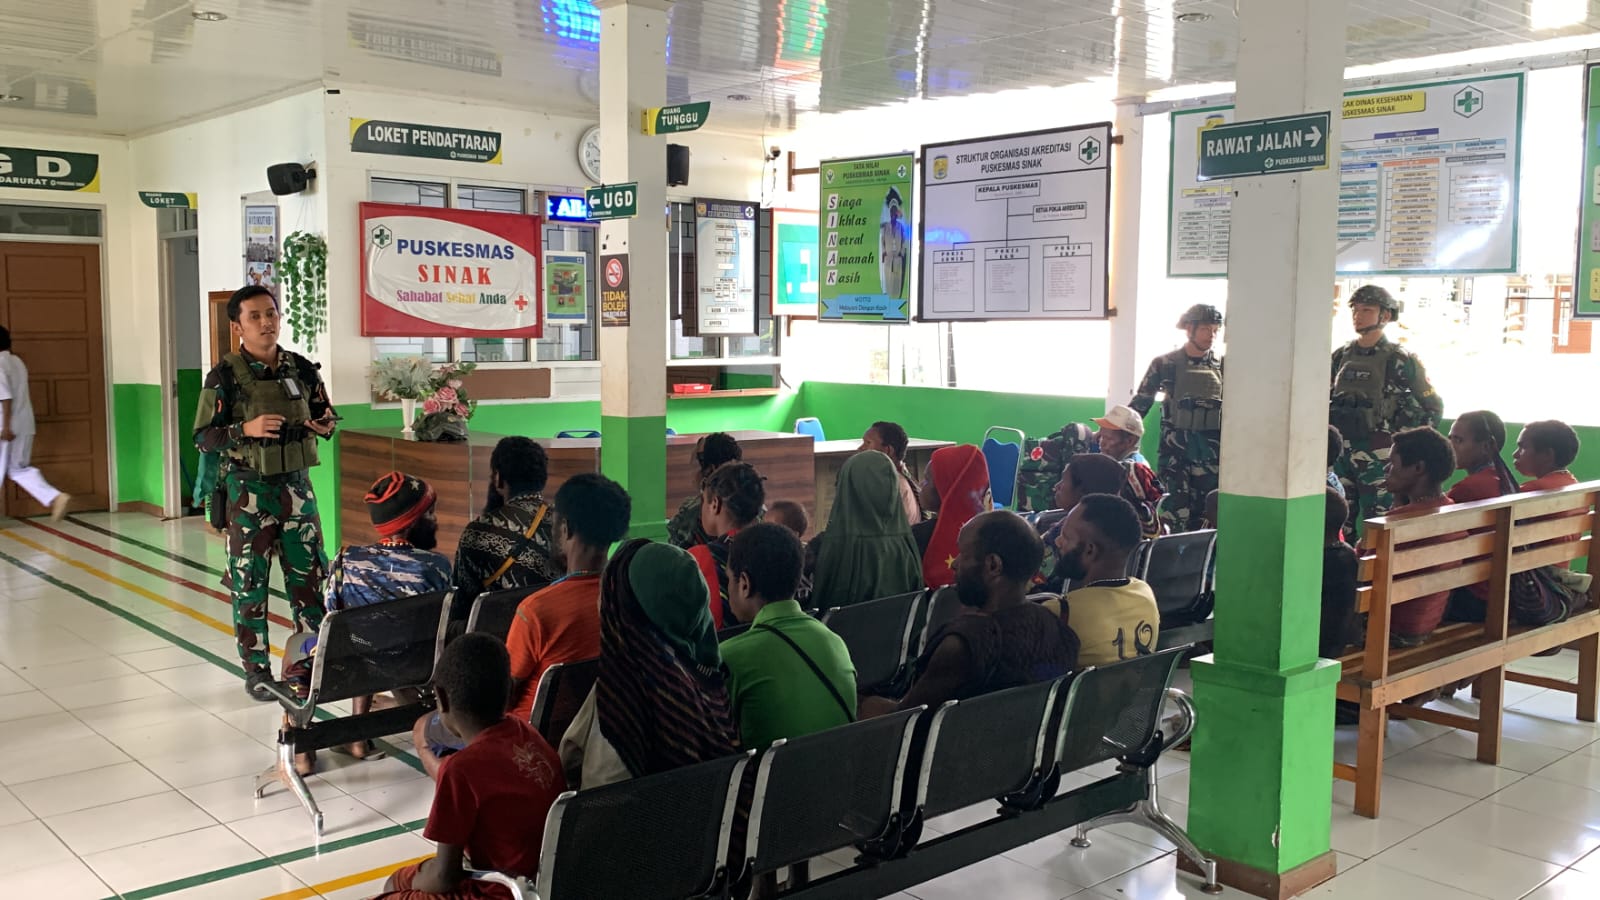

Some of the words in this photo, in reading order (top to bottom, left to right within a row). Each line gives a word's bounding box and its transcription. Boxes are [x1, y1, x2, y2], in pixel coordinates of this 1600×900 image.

[1356, 98, 1374, 106] DINAS
[1376, 94, 1412, 105] KESEHATAN
[1376, 105, 1395, 113] SINAK
[661, 113, 698, 127] TUNGGU
[368, 125, 409, 144] LOKET
[412, 129, 497, 152] PENDAFTARAN
[1206, 135, 1253, 157] RAWAT
[1256, 130, 1302, 152] JALAN
[956, 151, 989, 165] STRUKTUR
[990, 147, 1030, 162] ORGANISASI
[1031, 142, 1072, 156] AKREDITASI
[1275, 155, 1308, 166] PUSKESMAS
[1308, 153, 1325, 163] SINAK
[981, 160, 1021, 174] PUSKESMAS
[1022, 158, 1042, 170] SINAK
[978, 185, 1000, 194] KEPALA
[1001, 182, 1038, 192] PUSKESMAS
[150, 197, 175, 205] LOKET
[604, 191, 633, 208] UGD
[829, 195, 862, 210] Siaga
[831, 214, 867, 227] Ikhlas
[828, 233, 864, 246] Netral
[397, 239, 514, 260] PUSKESMAS
[828, 252, 874, 265] Amanah
[418, 264, 492, 285] SINAK
[828, 271, 860, 283] Kasih
[396, 290, 443, 303] Sahabat
[479, 292, 507, 305] Anda
[602, 290, 627, 302] TIDAK
[602, 301, 627, 312] BOLEH
